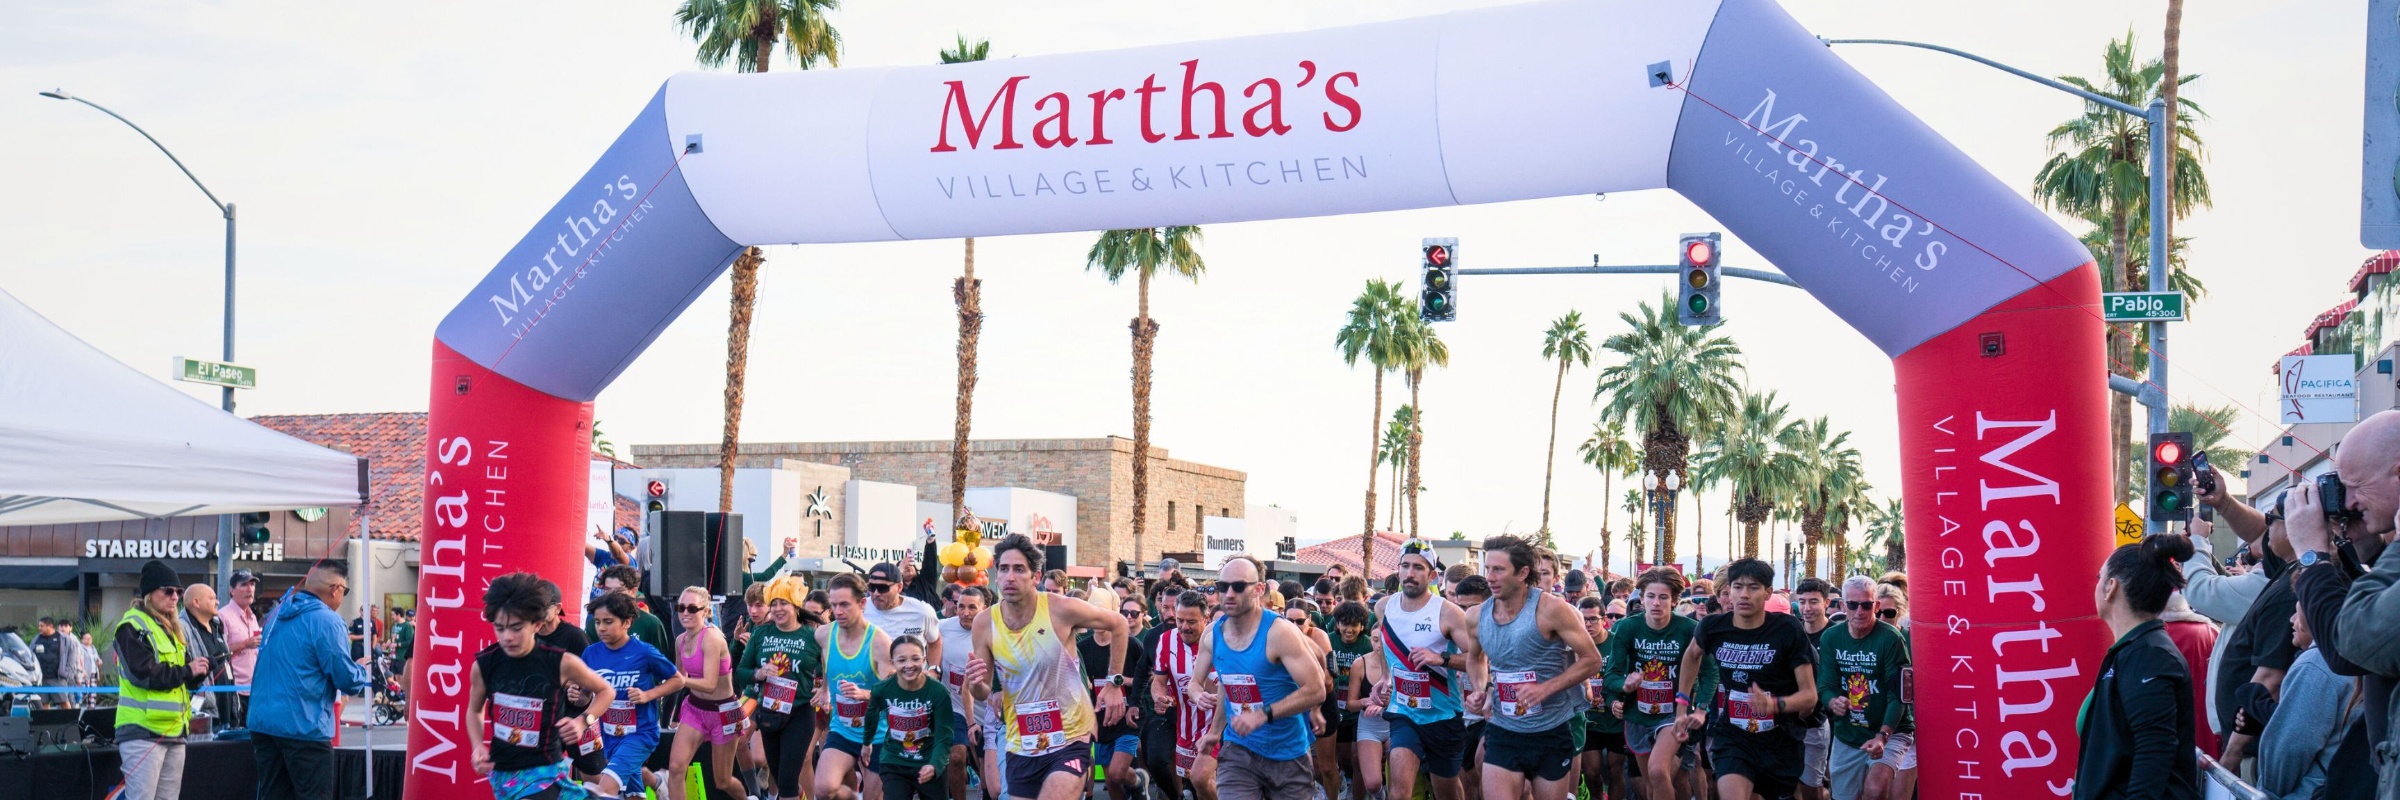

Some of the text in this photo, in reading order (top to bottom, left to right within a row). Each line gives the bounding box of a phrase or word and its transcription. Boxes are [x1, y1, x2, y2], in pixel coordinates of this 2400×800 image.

[930, 58, 1362, 153] Martha's
[936, 155, 1368, 200] VILLAGE & KITCHEN
[1737, 88, 1948, 271] Martha's
[1724, 131, 1920, 294] VILLAGE & KITCHEN
[489, 174, 638, 327] Martha's
[511, 277, 575, 340] VILLAGE
[586, 199, 654, 267] KITCHEN
[2112, 295, 2164, 312] Pablo
[2145, 309, 2176, 317] 45-300
[198, 361, 209, 376] El
[212, 363, 243, 380] Paseo
[2301, 379, 2352, 389] PACIFICA
[85, 538, 208, 559] STARBUCKS
[1207, 535, 1245, 552] Runners
[412, 436, 472, 784] Martha's
[1933, 415, 1983, 800] VILLAGE & KITCHE
[1976, 409, 2080, 797] Martha'
[1414, 623, 1432, 633] DWR
[1634, 638, 1680, 651] Martha's
[1723, 642, 1750, 651] SHADOW
[1836, 649, 1877, 662] Martha's
[1524, 673, 1535, 681] 5K
[1668, 664, 1678, 679] K
[1230, 685, 1252, 702] 613
[1401, 680, 1421, 695] 468
[1868, 679, 1880, 694] K
[1047, 700, 1059, 709] 5K
[499, 707, 535, 728] 2063
[893, 716, 923, 730] 2304
[1026, 713, 1053, 733] 935
